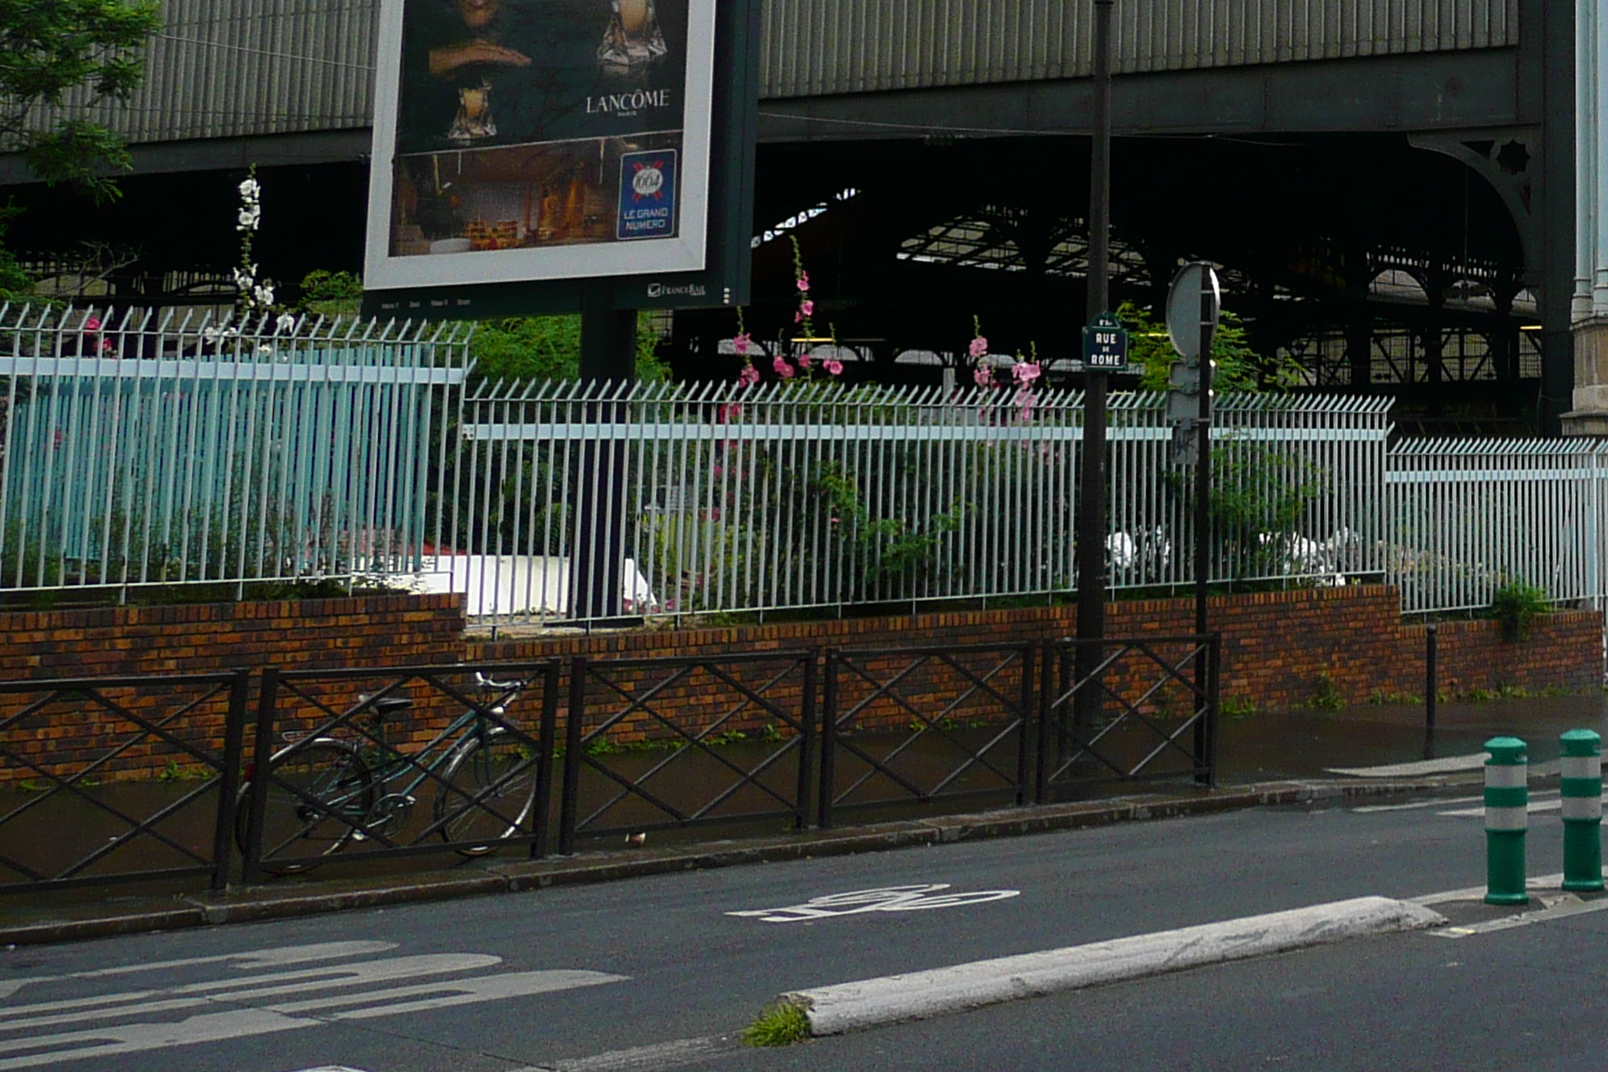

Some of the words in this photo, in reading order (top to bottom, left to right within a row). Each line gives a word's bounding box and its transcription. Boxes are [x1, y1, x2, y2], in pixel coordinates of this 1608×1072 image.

[586, 89, 670, 113] LANCÔME
[624, 210, 636, 220] LE
[637, 208, 669, 219] GRAND
[1096, 333, 1117, 344] RUE
[1091, 354, 1120, 366] ROME
